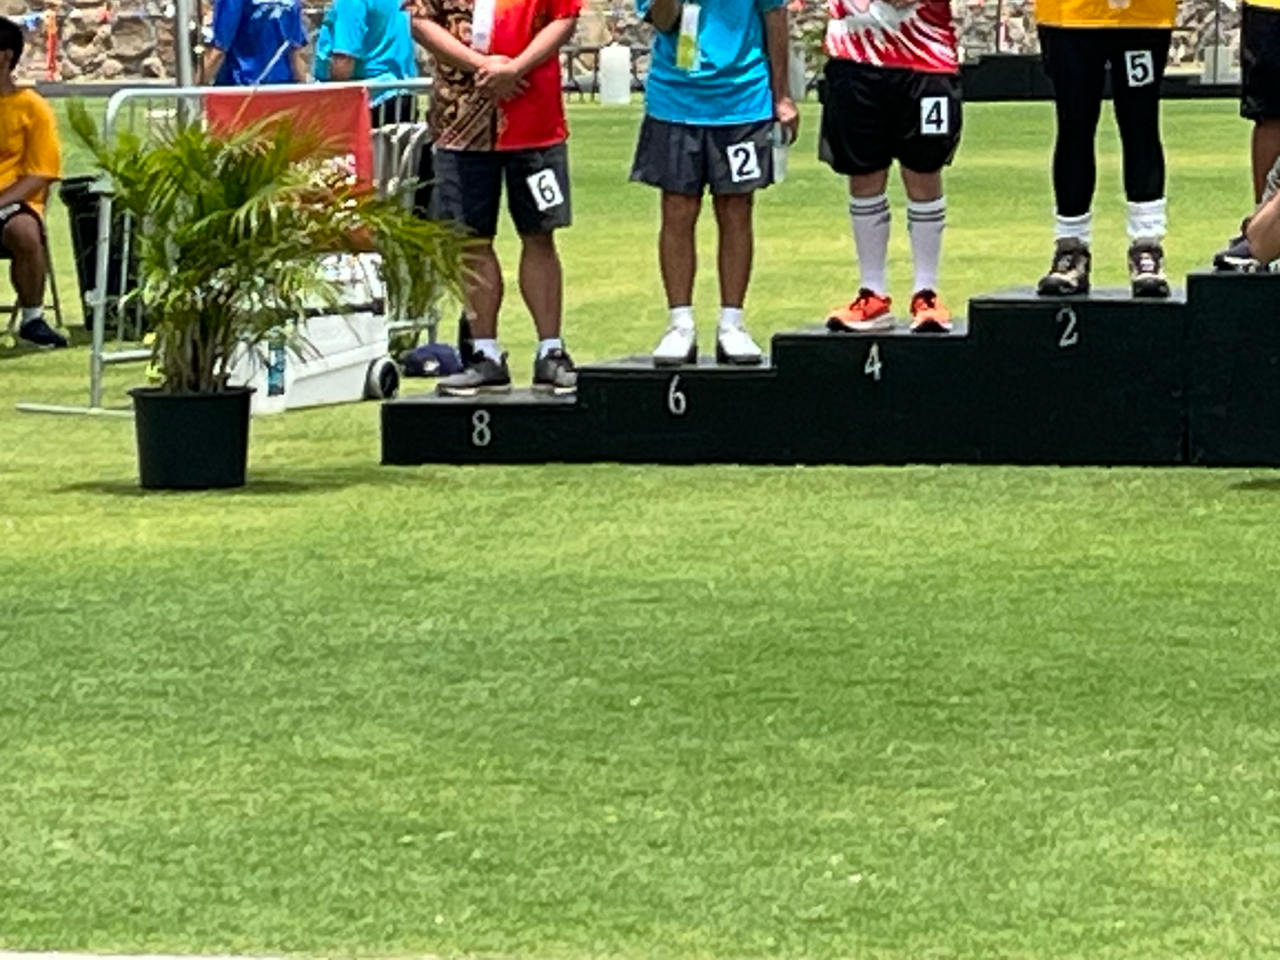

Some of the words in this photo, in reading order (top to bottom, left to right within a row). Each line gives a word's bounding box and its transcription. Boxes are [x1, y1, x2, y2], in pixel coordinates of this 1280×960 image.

[1130, 53, 1150, 83] 5
[925, 100, 944, 132] 4
[732, 147, 755, 177] 2
[538, 174, 556, 204] 6
[1055, 306, 1079, 348] 2
[864, 341, 882, 381] 4
[668, 374, 687, 415] 6
[471, 409, 491, 447] 8
